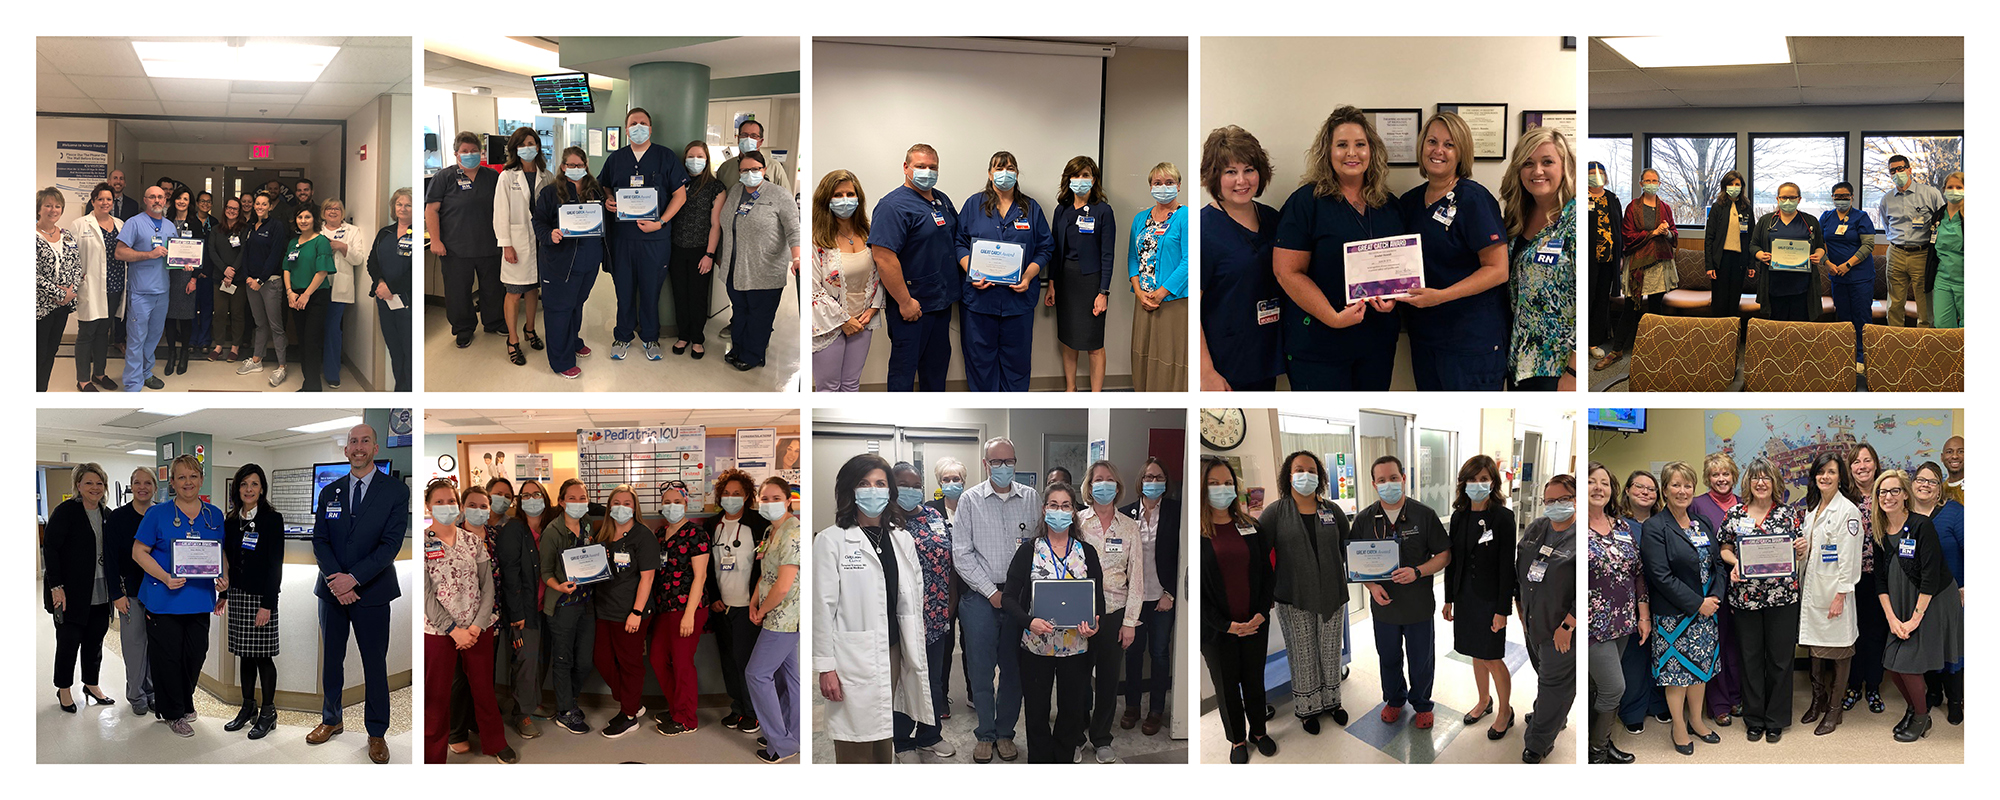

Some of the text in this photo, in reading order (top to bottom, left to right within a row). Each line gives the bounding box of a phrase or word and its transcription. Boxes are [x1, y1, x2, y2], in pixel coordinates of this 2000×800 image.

[253, 146, 270, 158] EXIT
[1538, 254, 1554, 264] RN
[604, 428, 657, 440] Pediatric
[660, 428, 678, 439] ICU
